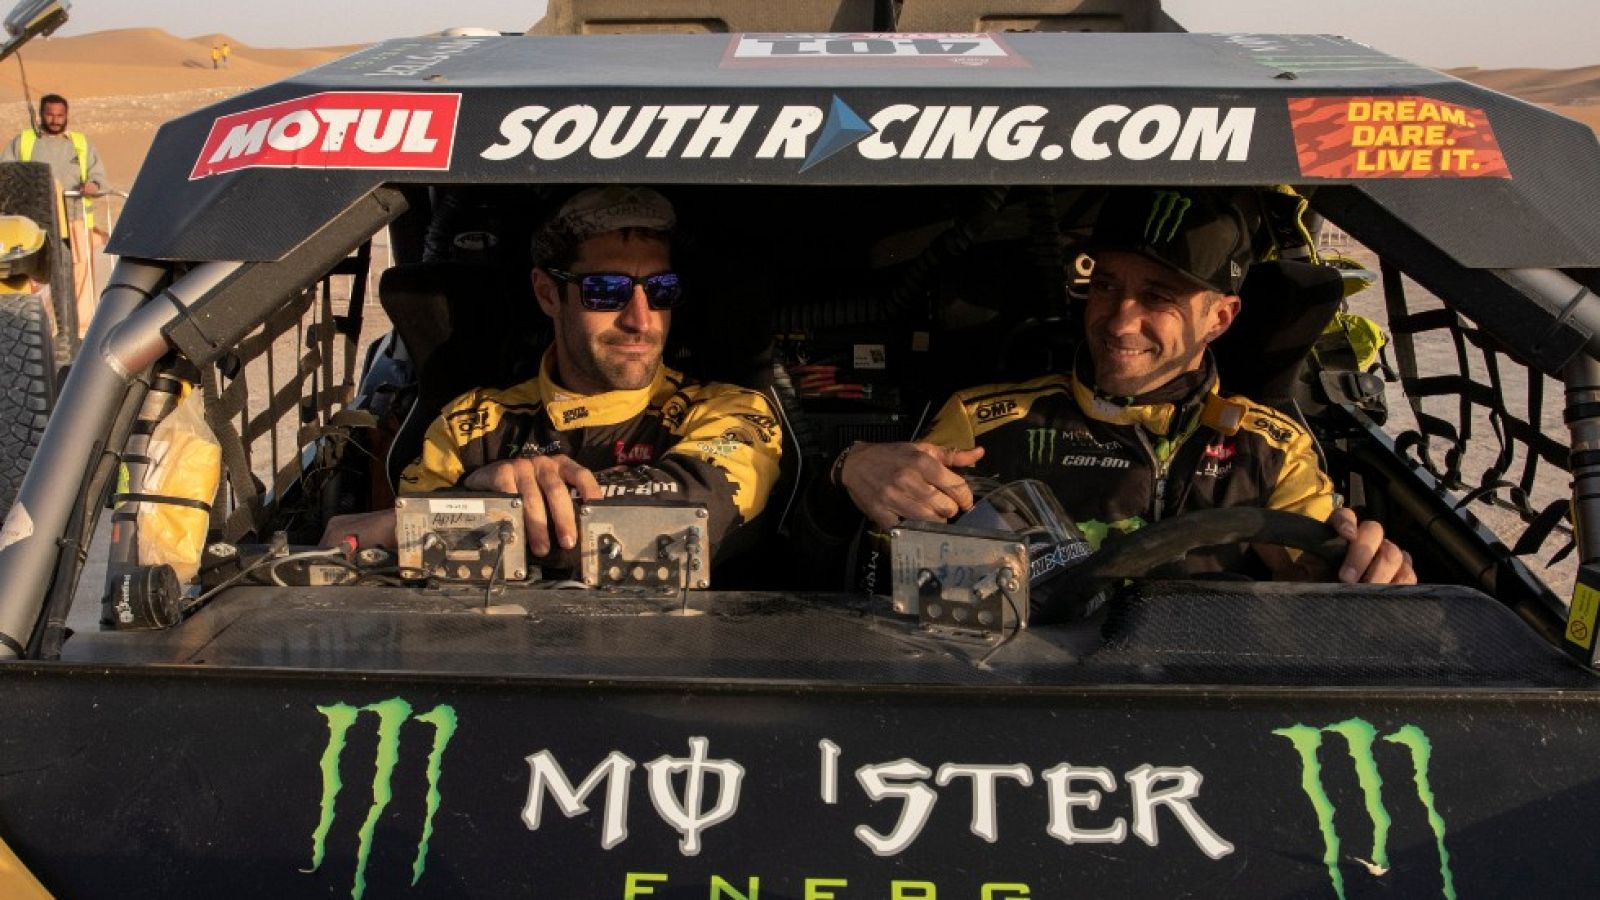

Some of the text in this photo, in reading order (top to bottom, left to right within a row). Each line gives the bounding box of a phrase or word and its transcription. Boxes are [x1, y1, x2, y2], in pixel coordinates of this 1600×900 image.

[756, 38, 980, 55] 401
[1347, 100, 1476, 129] DREAM.
[207, 108, 438, 164] MOTUL
[479, 104, 760, 161] SOUTH
[1351, 125, 1456, 148] DARE.
[1356, 149, 1481, 171] LIVE IT.
[977, 402, 1018, 419] OMP
[1062, 455, 1130, 468] can-am
[571, 481, 678, 497] n-am
